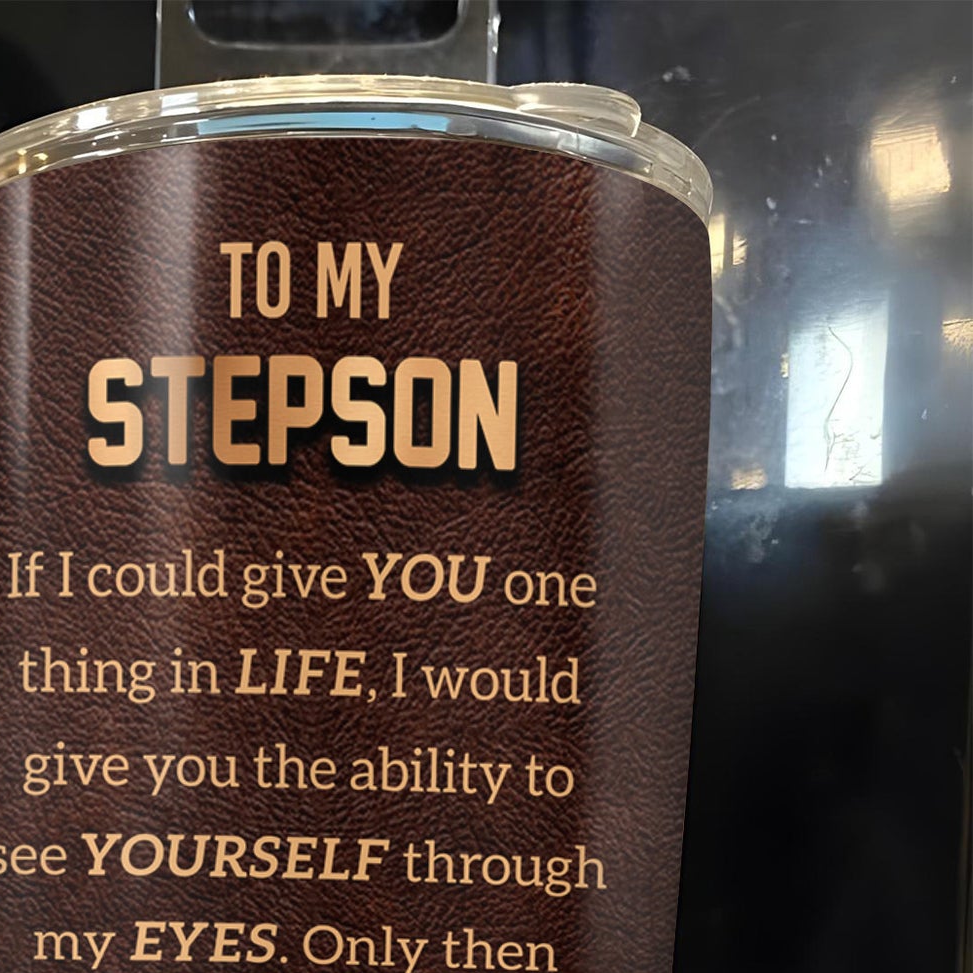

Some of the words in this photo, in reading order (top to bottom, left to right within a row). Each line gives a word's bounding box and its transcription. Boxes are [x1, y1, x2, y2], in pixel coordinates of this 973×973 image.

[219, 240, 291, 318] TO
[316, 241, 404, 319] MY
[88, 354, 518, 471] STEPSON
[7, 551, 44, 599] If
[58, 551, 74, 597] I
[87, 548, 228, 598] could
[241, 550, 347, 609] give
[361, 552, 492, 603] YOU
[504, 570, 597, 608] one
[18, 646, 157, 704] thing
[170, 646, 221, 694] in
[234, 648, 376, 703] LIFE,
[391, 652, 408, 698] I
[420, 655, 581, 704] would
[23, 741, 129, 796] give
[143, 754, 240, 797] you
[253, 743, 336, 790] the
[350, 746, 512, 805] ability
[525, 754, 574, 797] to
[81, 833, 390, 881] YOURSELF
[403, 839, 607, 897] through
[33, 931, 116, 970] my
[129, 921, 288, 964] EYES.
[442, 927, 558, 972] then
